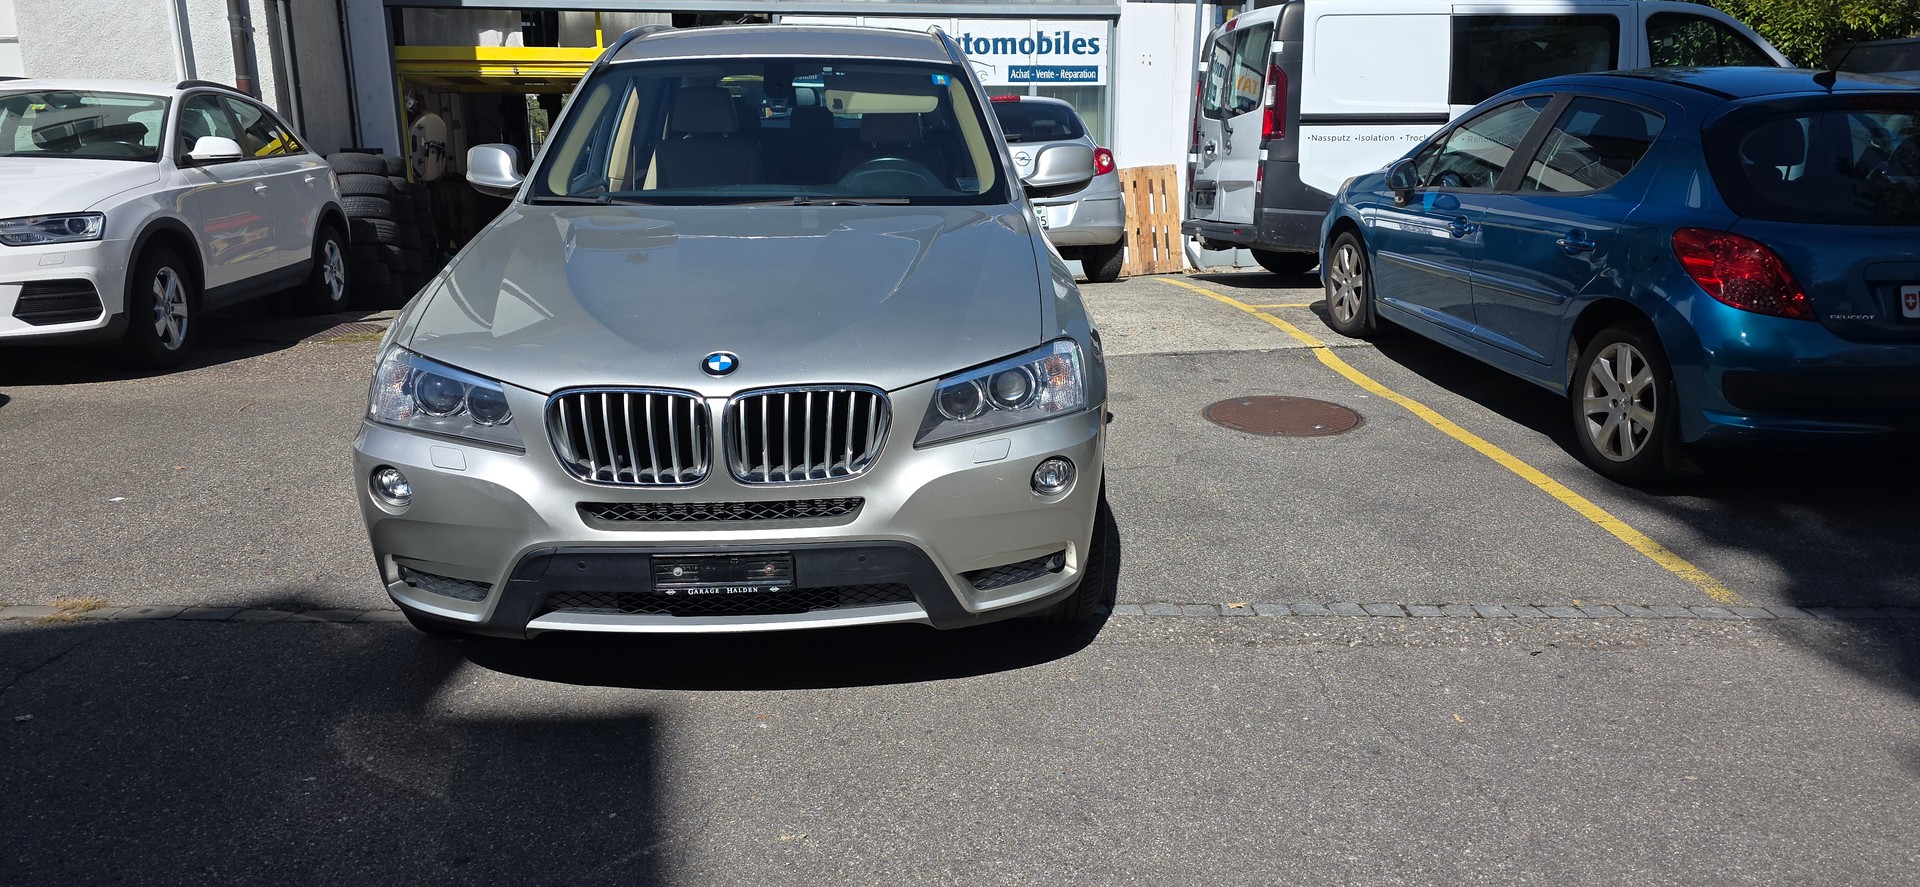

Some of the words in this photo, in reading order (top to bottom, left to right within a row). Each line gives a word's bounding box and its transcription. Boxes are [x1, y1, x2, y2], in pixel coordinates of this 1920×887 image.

[1010, 68, 1030, 79] Achat
[1035, 68, 1054, 79] Vente
[1060, 68, 1096, 81] Réparation
[1311, 134, 1351, 142] Nassputz
[1358, 134, 1395, 142] Isolation
